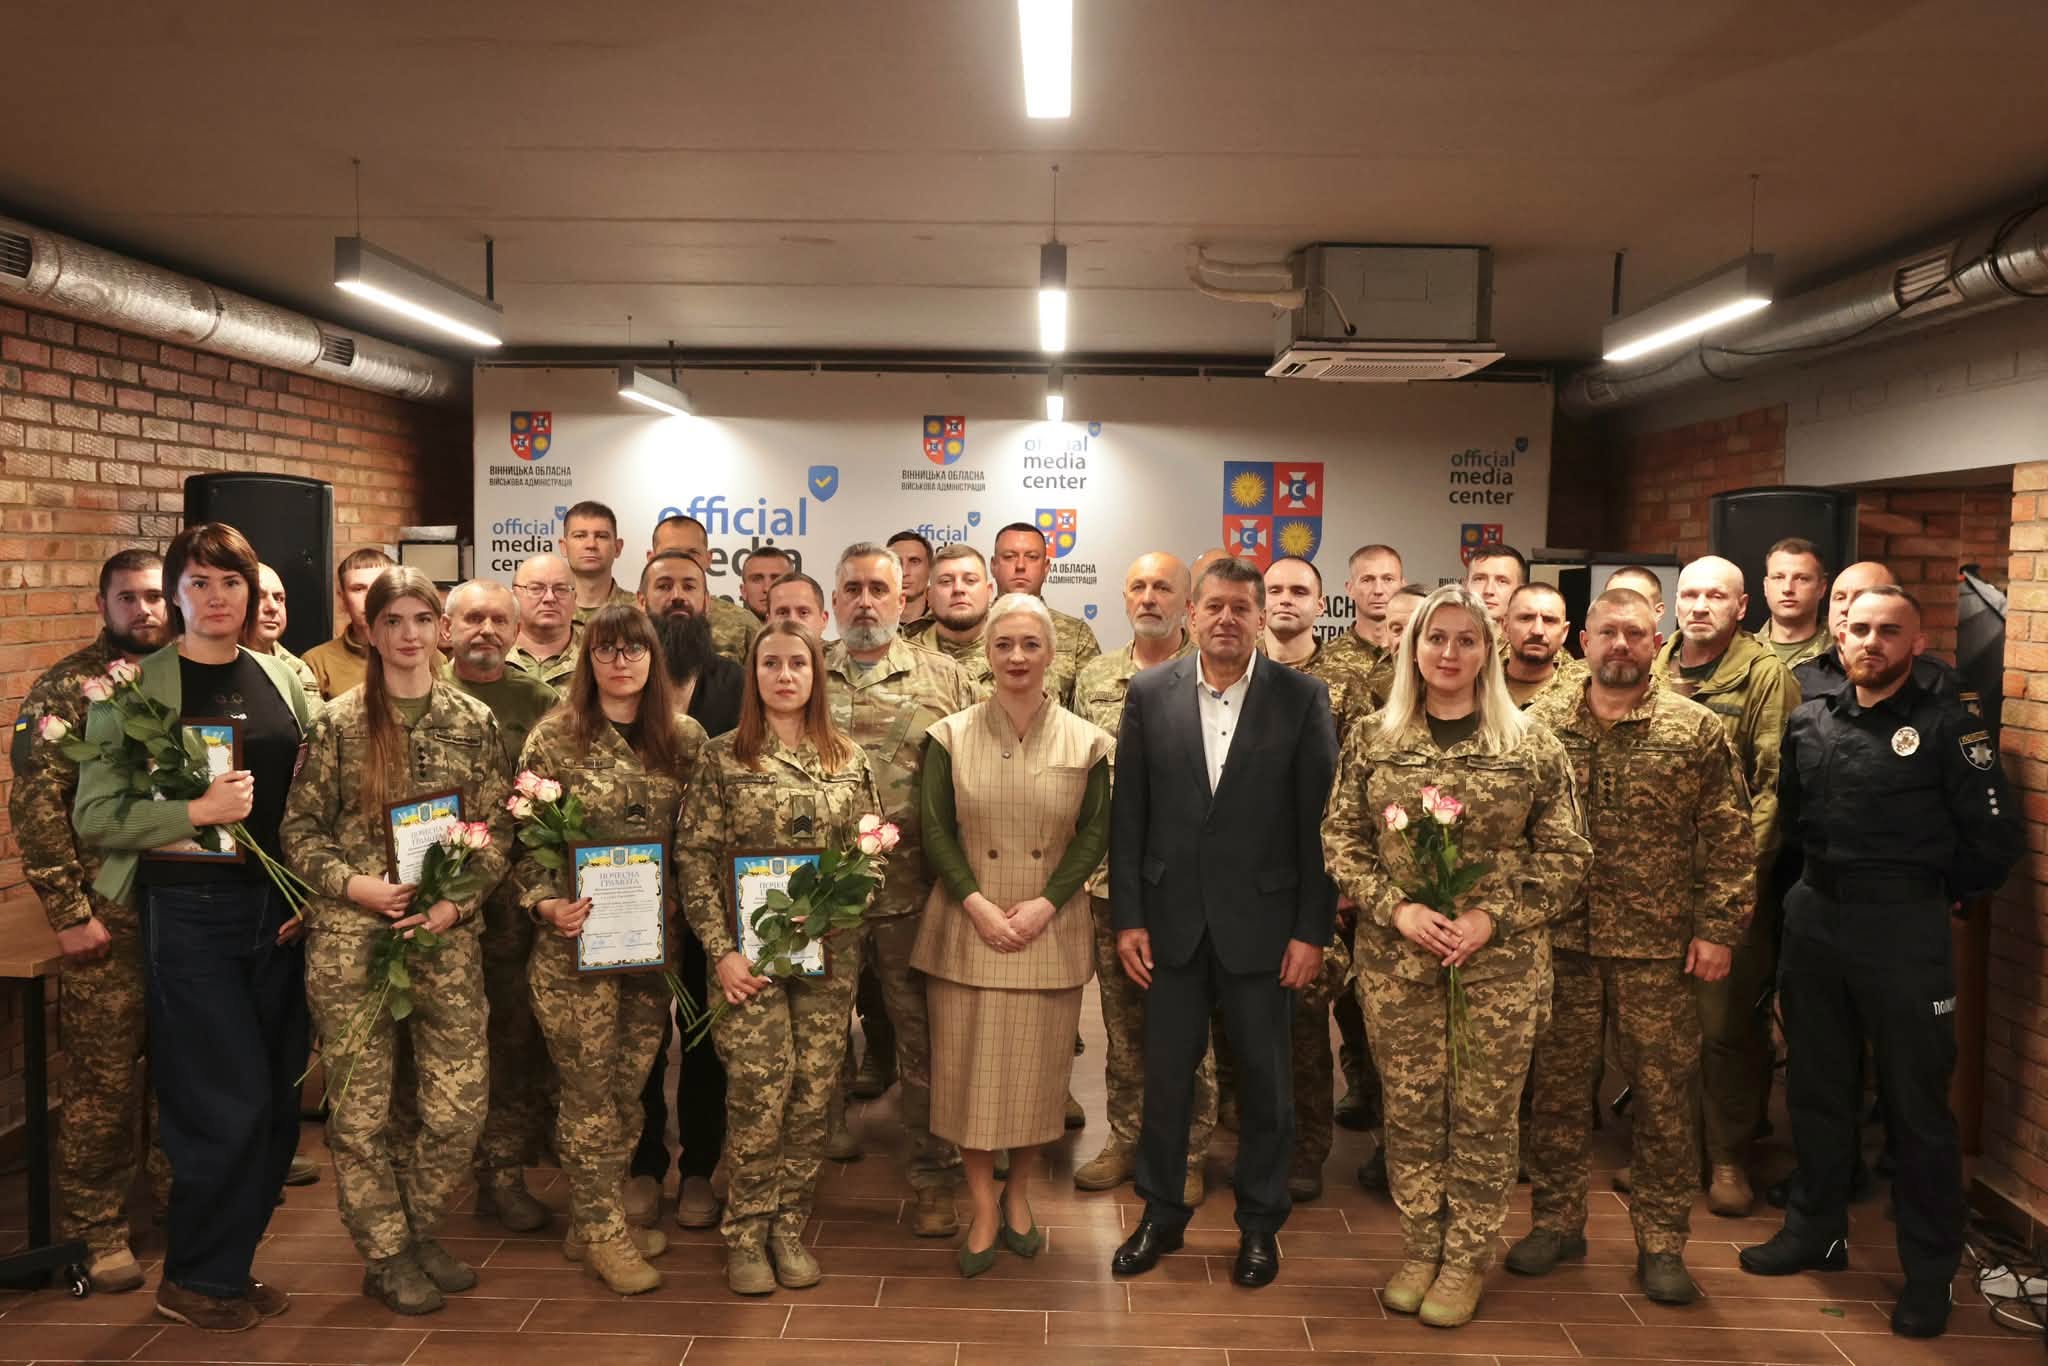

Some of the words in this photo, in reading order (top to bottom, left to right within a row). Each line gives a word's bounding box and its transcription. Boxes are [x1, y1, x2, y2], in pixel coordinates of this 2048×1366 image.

[1024, 452, 1086, 469] media
[1451, 449, 1515, 467] official
[489, 465, 534, 476] ВІННИЦЬКА
[535, 465, 571, 476] ОБЛАСНА
[902, 470, 946, 480] ВІННИЦЬКА
[947, 470, 984, 480] ОБЛАСНА
[1450, 467, 1513, 485] media
[1023, 474, 1087, 489] center
[1449, 488, 1515, 505] center
[492, 518, 555, 535] official
[906, 524, 968, 541] fficial
[492, 535, 553, 552] media
[1059, 563, 1097, 574] ОБЛАСНА
